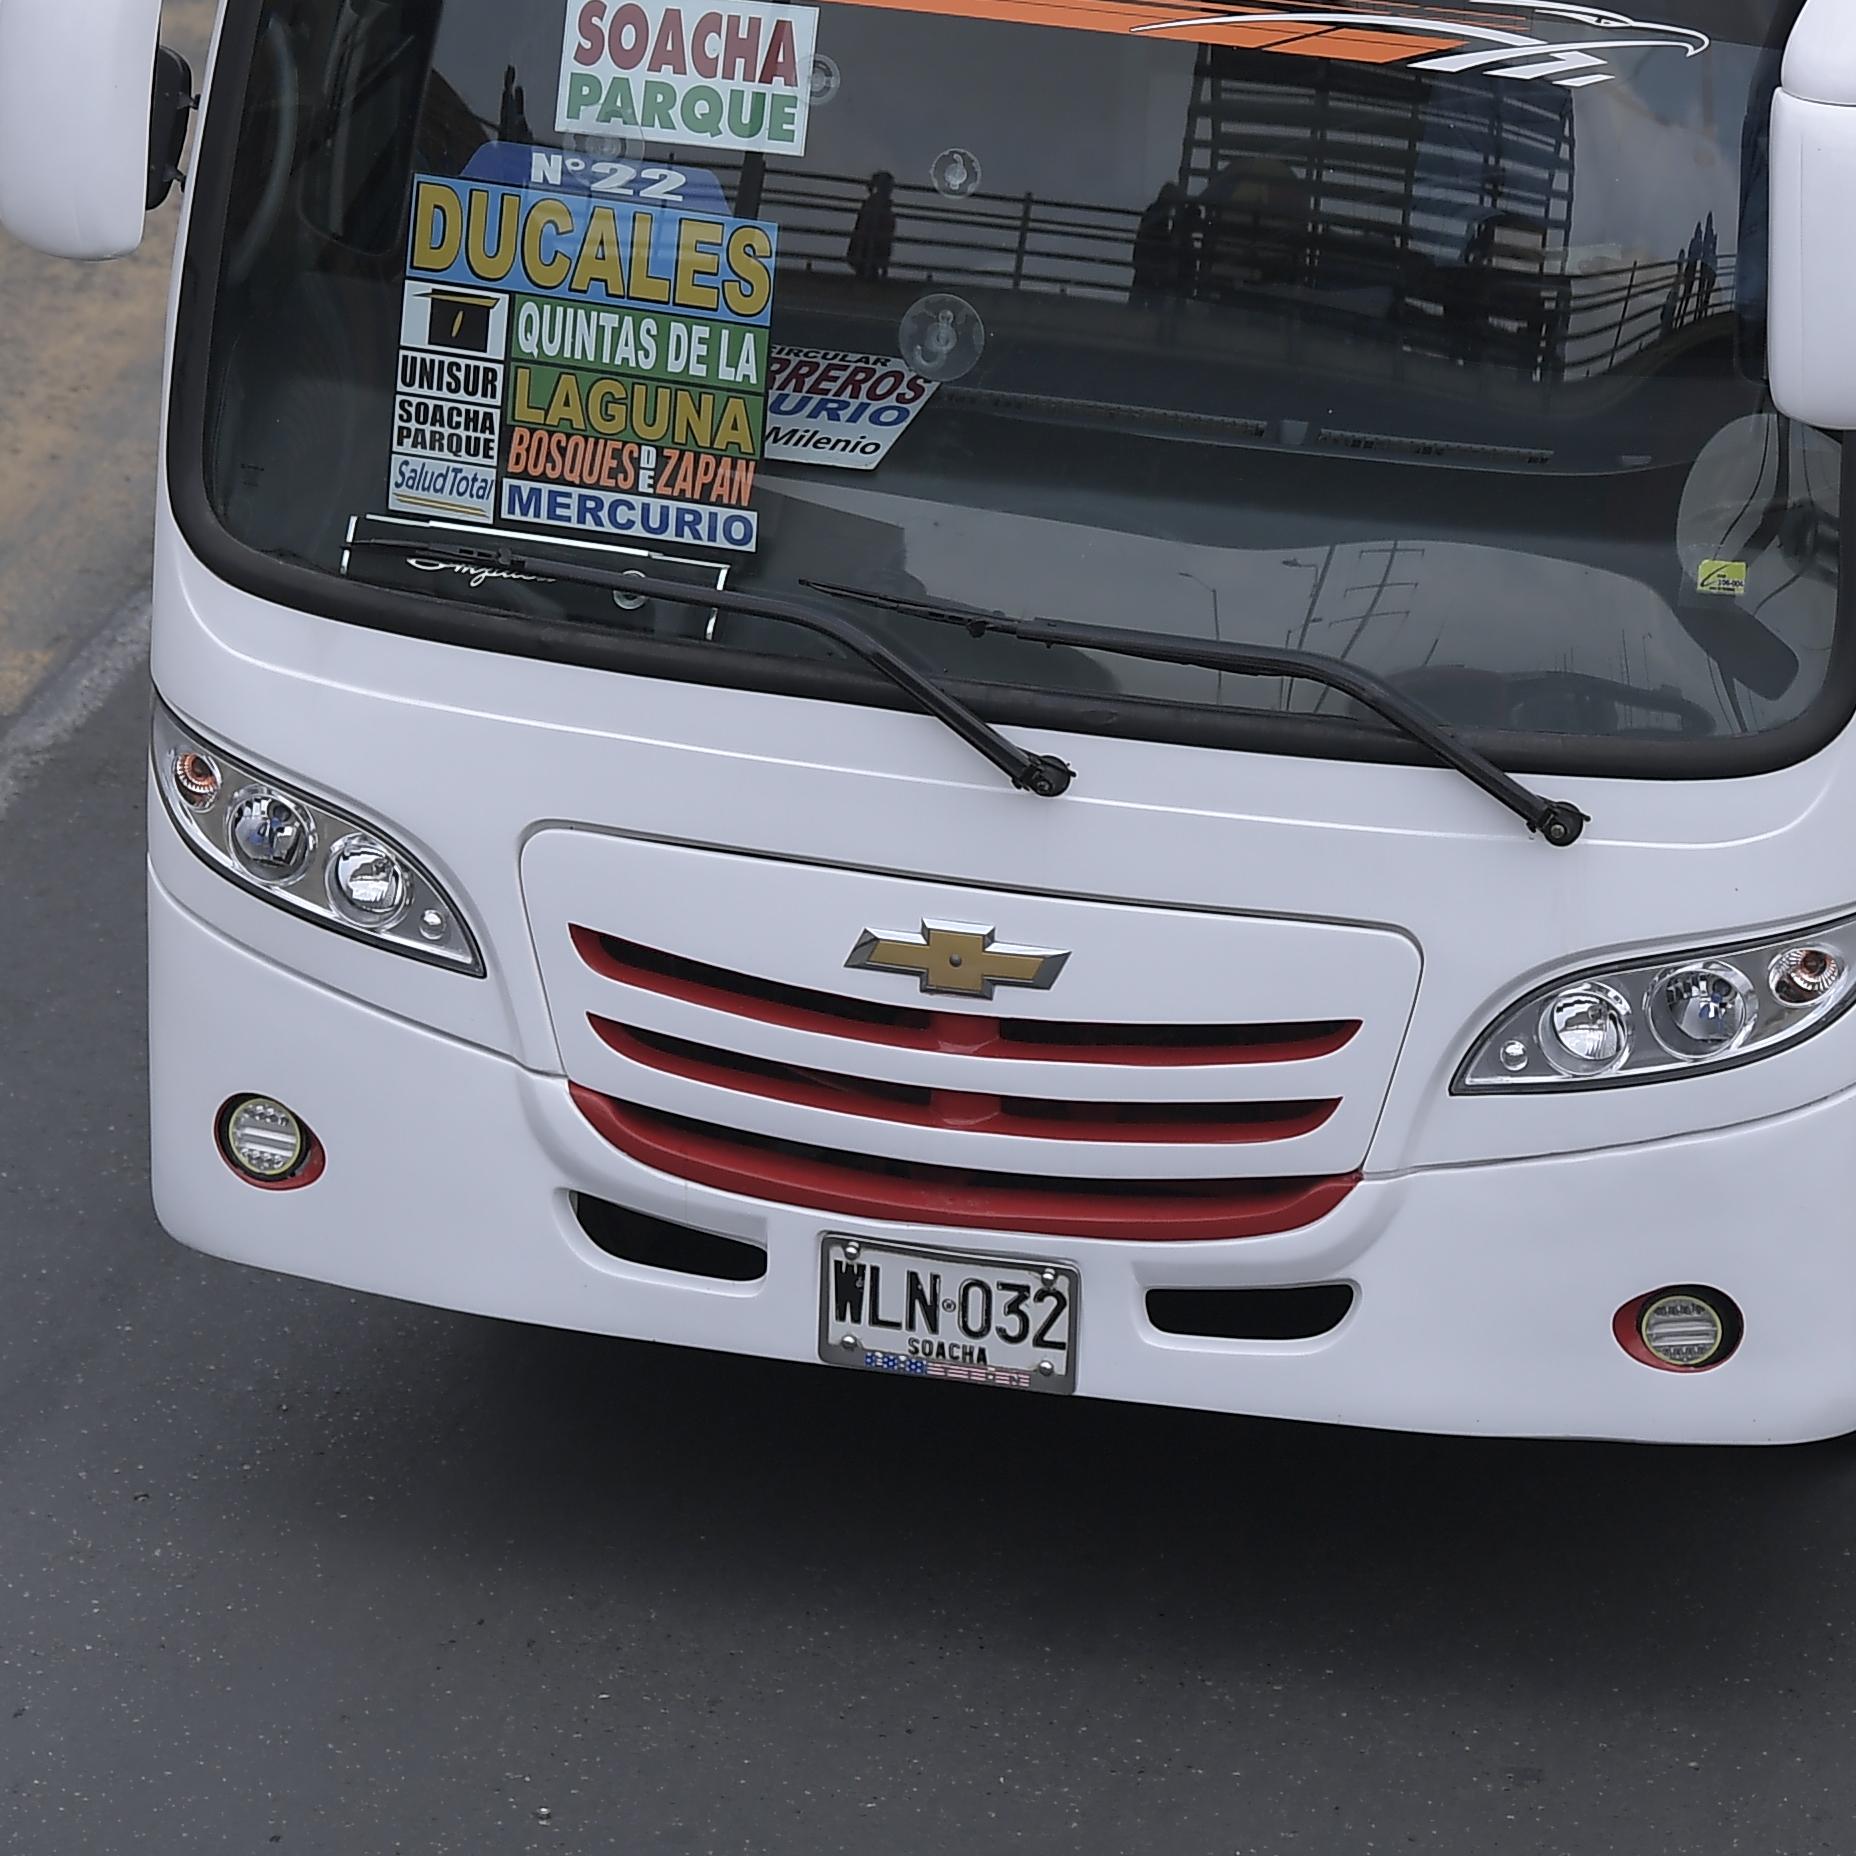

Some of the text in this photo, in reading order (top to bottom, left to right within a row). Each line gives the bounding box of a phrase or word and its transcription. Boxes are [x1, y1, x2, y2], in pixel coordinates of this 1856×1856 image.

[565, 71, 799, 144] PARQUE
[410, 182, 773, 318] DUCALES
[518, 301, 758, 385] QUINTAS DE LA
[399, 354, 499, 400] UNISUR
[398, 398, 496, 436] SOACHA
[514, 367, 755, 454] LAGUNA
[769, 392, 911, 427] URIO
[396, 425, 496, 460] PARQUE
[507, 426, 639, 491] BOSQUES
[656, 448, 756, 507] ZAPAN
[764, 426, 882, 455] Milenio
[507, 484, 755, 547] MERCURIO
[907, 1336, 988, 1366] SOACHA
